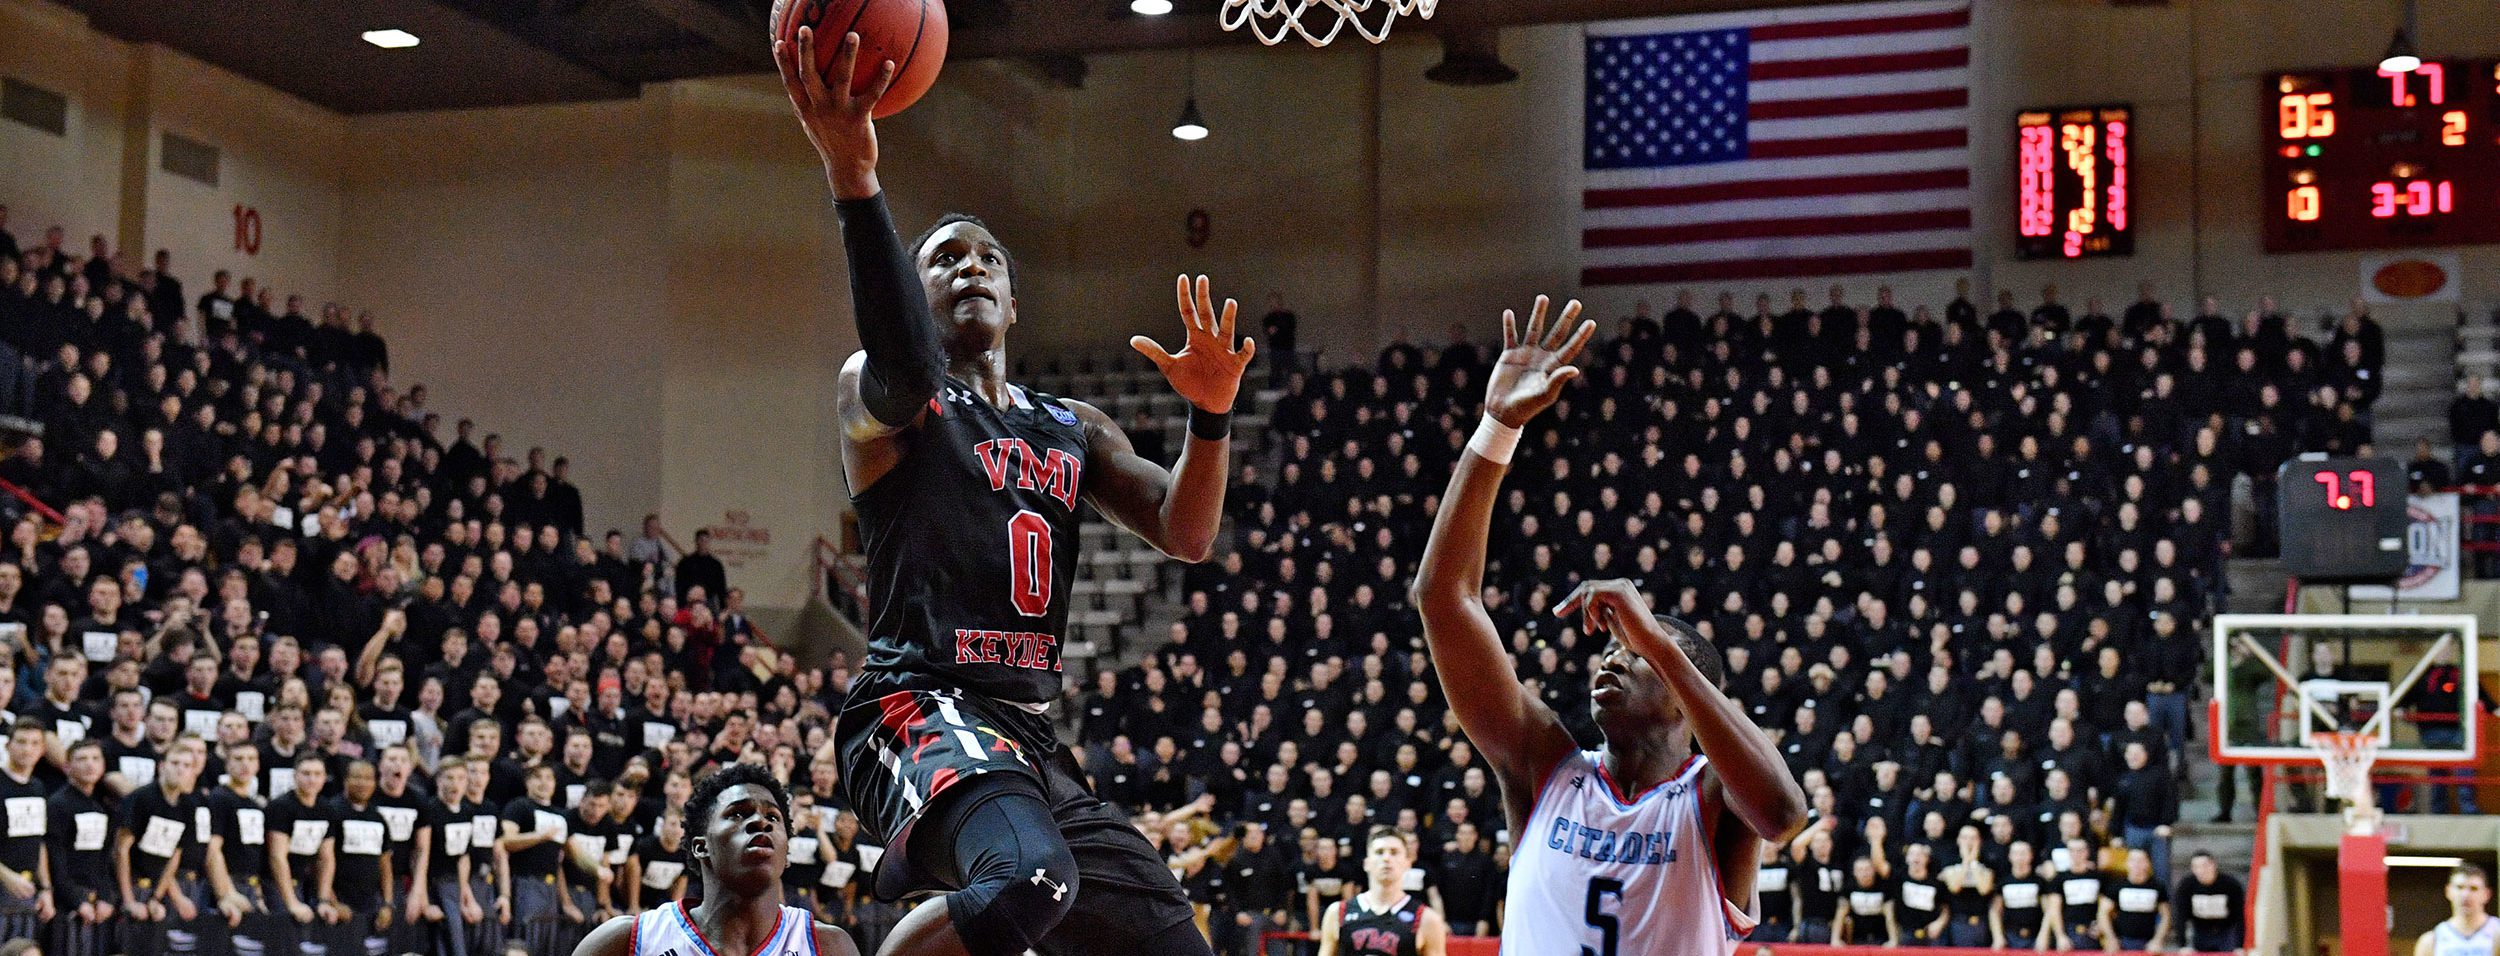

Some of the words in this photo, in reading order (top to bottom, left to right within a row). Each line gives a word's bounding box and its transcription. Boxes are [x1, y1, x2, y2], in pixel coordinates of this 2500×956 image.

[2442, 110, 2467, 146] 2
[2288, 186, 2319, 221] 10
[233, 203, 262, 256] 10
[1187, 209, 1210, 249] 9
[2064, 231, 2082, 257] 2
[974, 437, 1081, 513] VMI
[2314, 470, 2375, 510] 7.7
[1007, 508, 1053, 618] 0
[1548, 816, 1677, 865] CITADEL
[1580, 875, 1625, 956] 5
